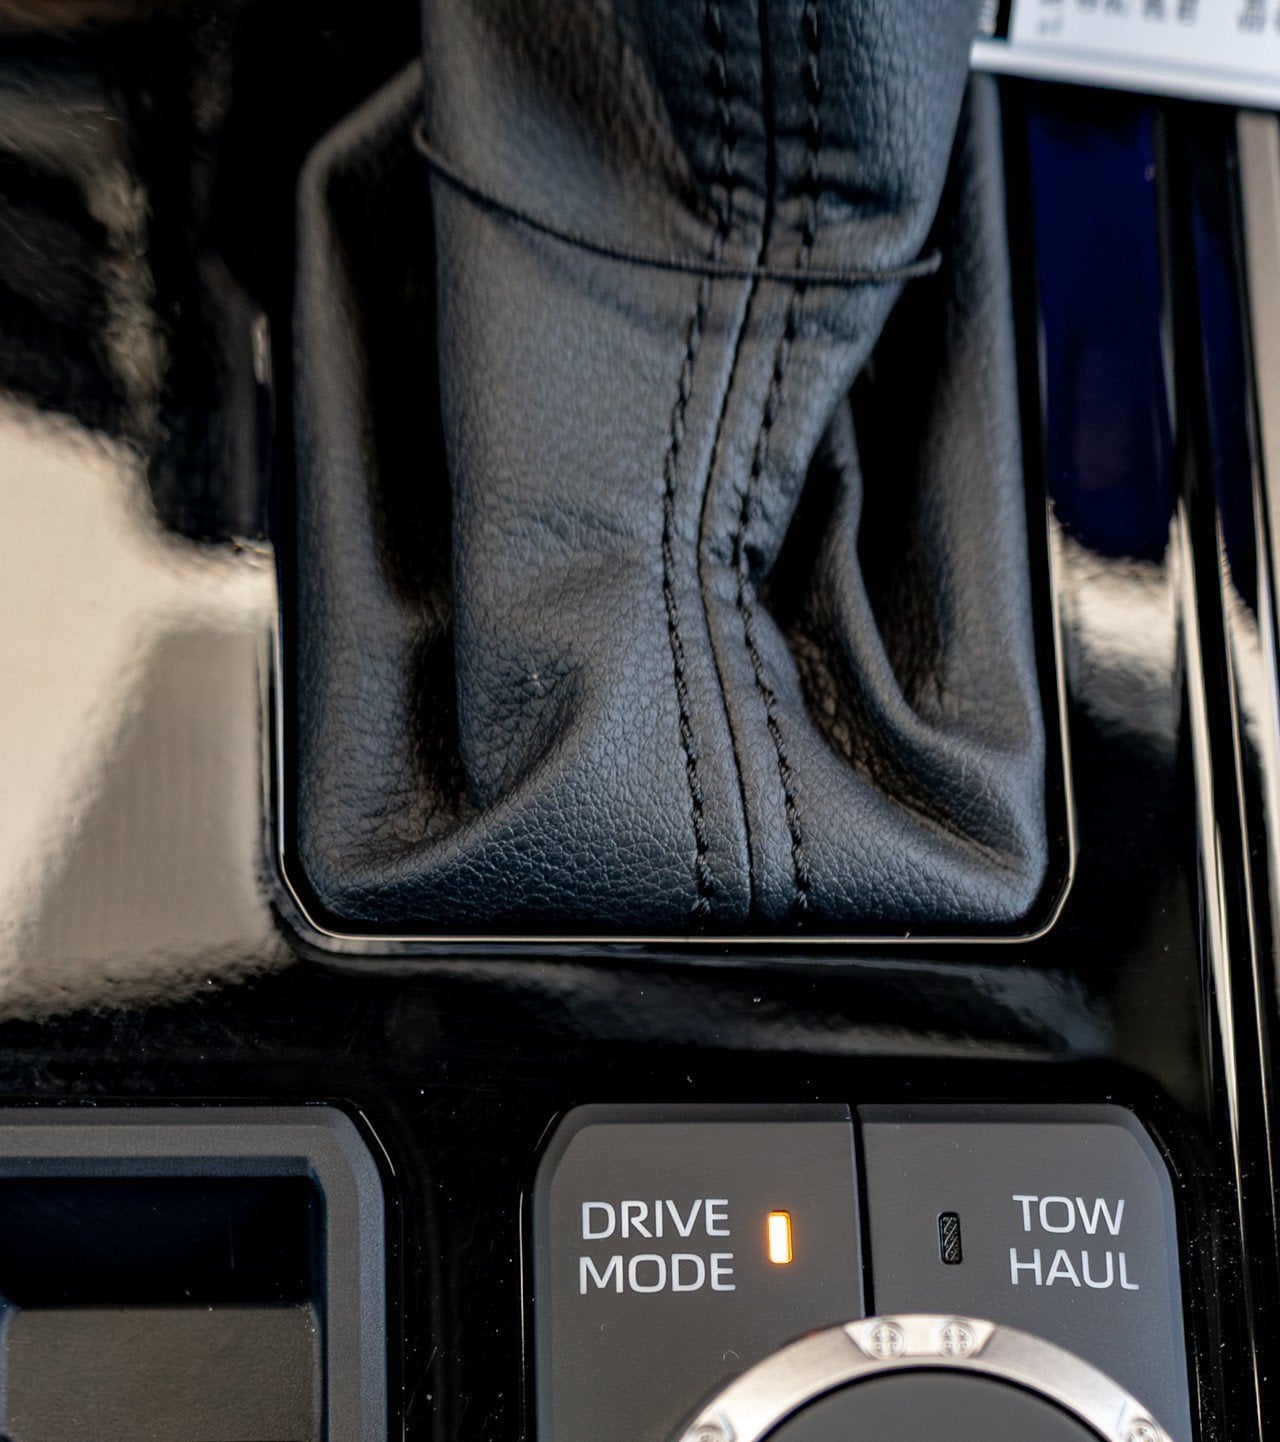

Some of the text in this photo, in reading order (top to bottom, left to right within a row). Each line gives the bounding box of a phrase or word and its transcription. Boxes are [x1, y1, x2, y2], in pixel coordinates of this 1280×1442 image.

[580, 1198, 732, 1241] DRIVE
[1011, 1194, 1126, 1236] TOW
[578, 1252, 737, 1295] MODE
[1008, 1247, 1140, 1292] HAUL
